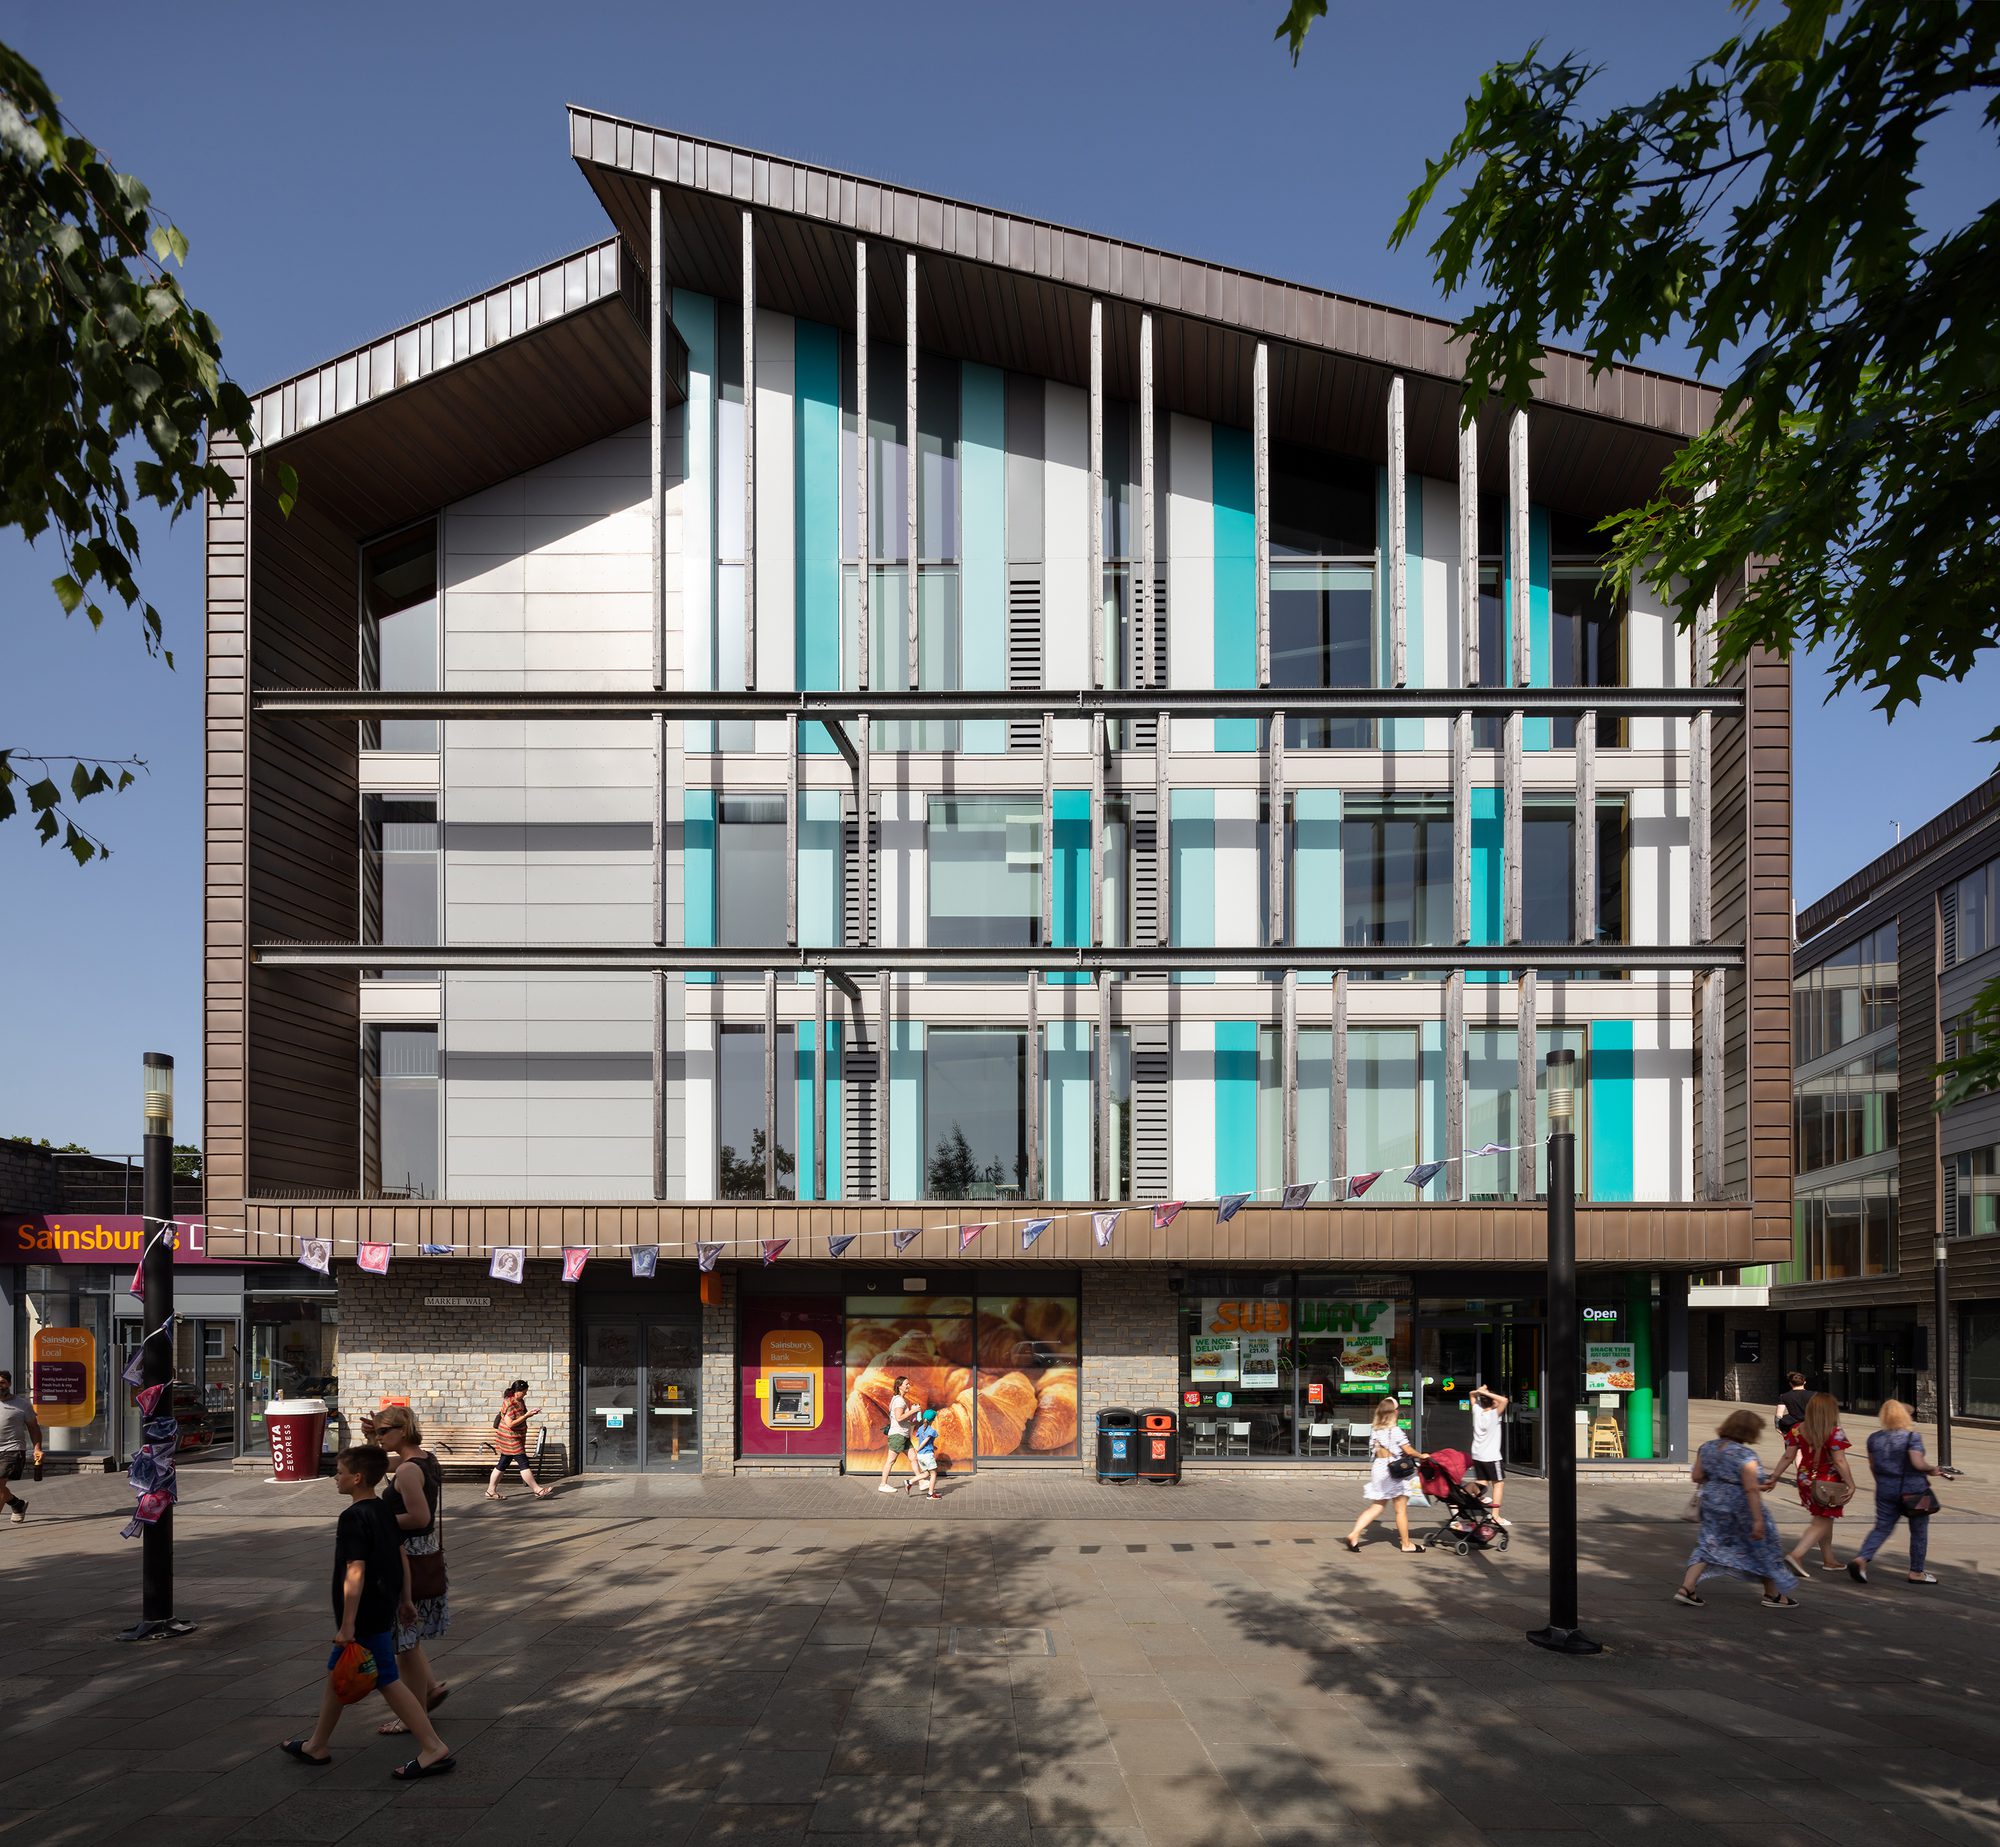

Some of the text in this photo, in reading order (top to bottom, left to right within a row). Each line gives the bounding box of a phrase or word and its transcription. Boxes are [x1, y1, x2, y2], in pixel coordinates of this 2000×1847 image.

[18, 1224, 180, 1250] Sainsburs
[1583, 1308, 1617, 1321] Open
[42, 1336, 86, 1345] Sainsbury's
[770, 1341, 812, 1350] Sainsbury's
[272, 1424, 284, 1471] COSTA
[284, 1424, 293, 1464] EXPRESS
